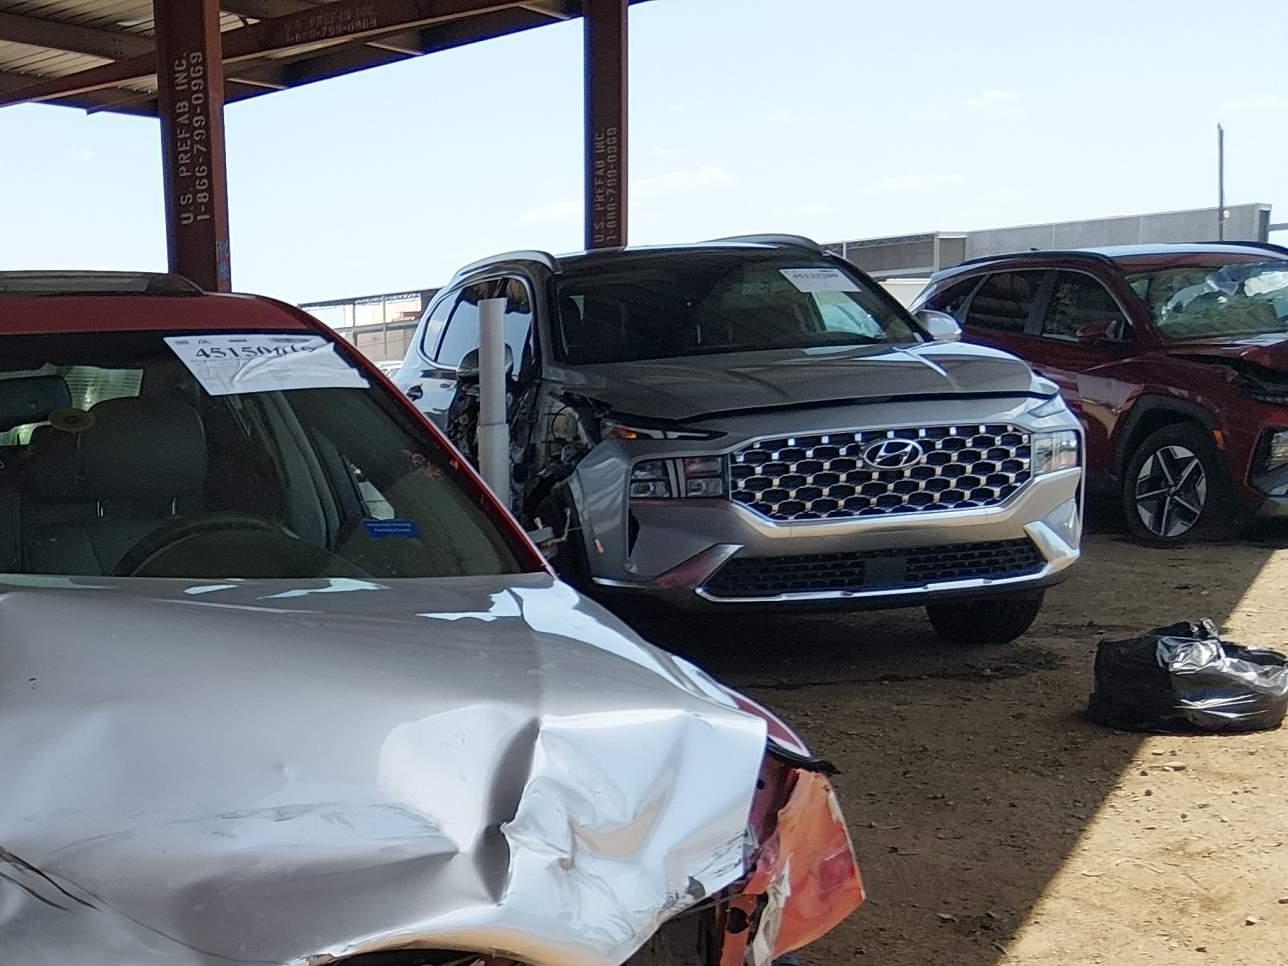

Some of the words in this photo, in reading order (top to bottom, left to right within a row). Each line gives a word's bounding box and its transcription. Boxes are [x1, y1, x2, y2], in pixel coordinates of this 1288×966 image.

[174, 53, 189, 90] INC.
[176, 100, 191, 176] PREFAB
[190, 51, 210, 220] 1-866-799-0969
[180, 188, 194, 225] U.S.
[594, 160, 606, 211] PREFAB
[594, 217, 605, 243] U.S.
